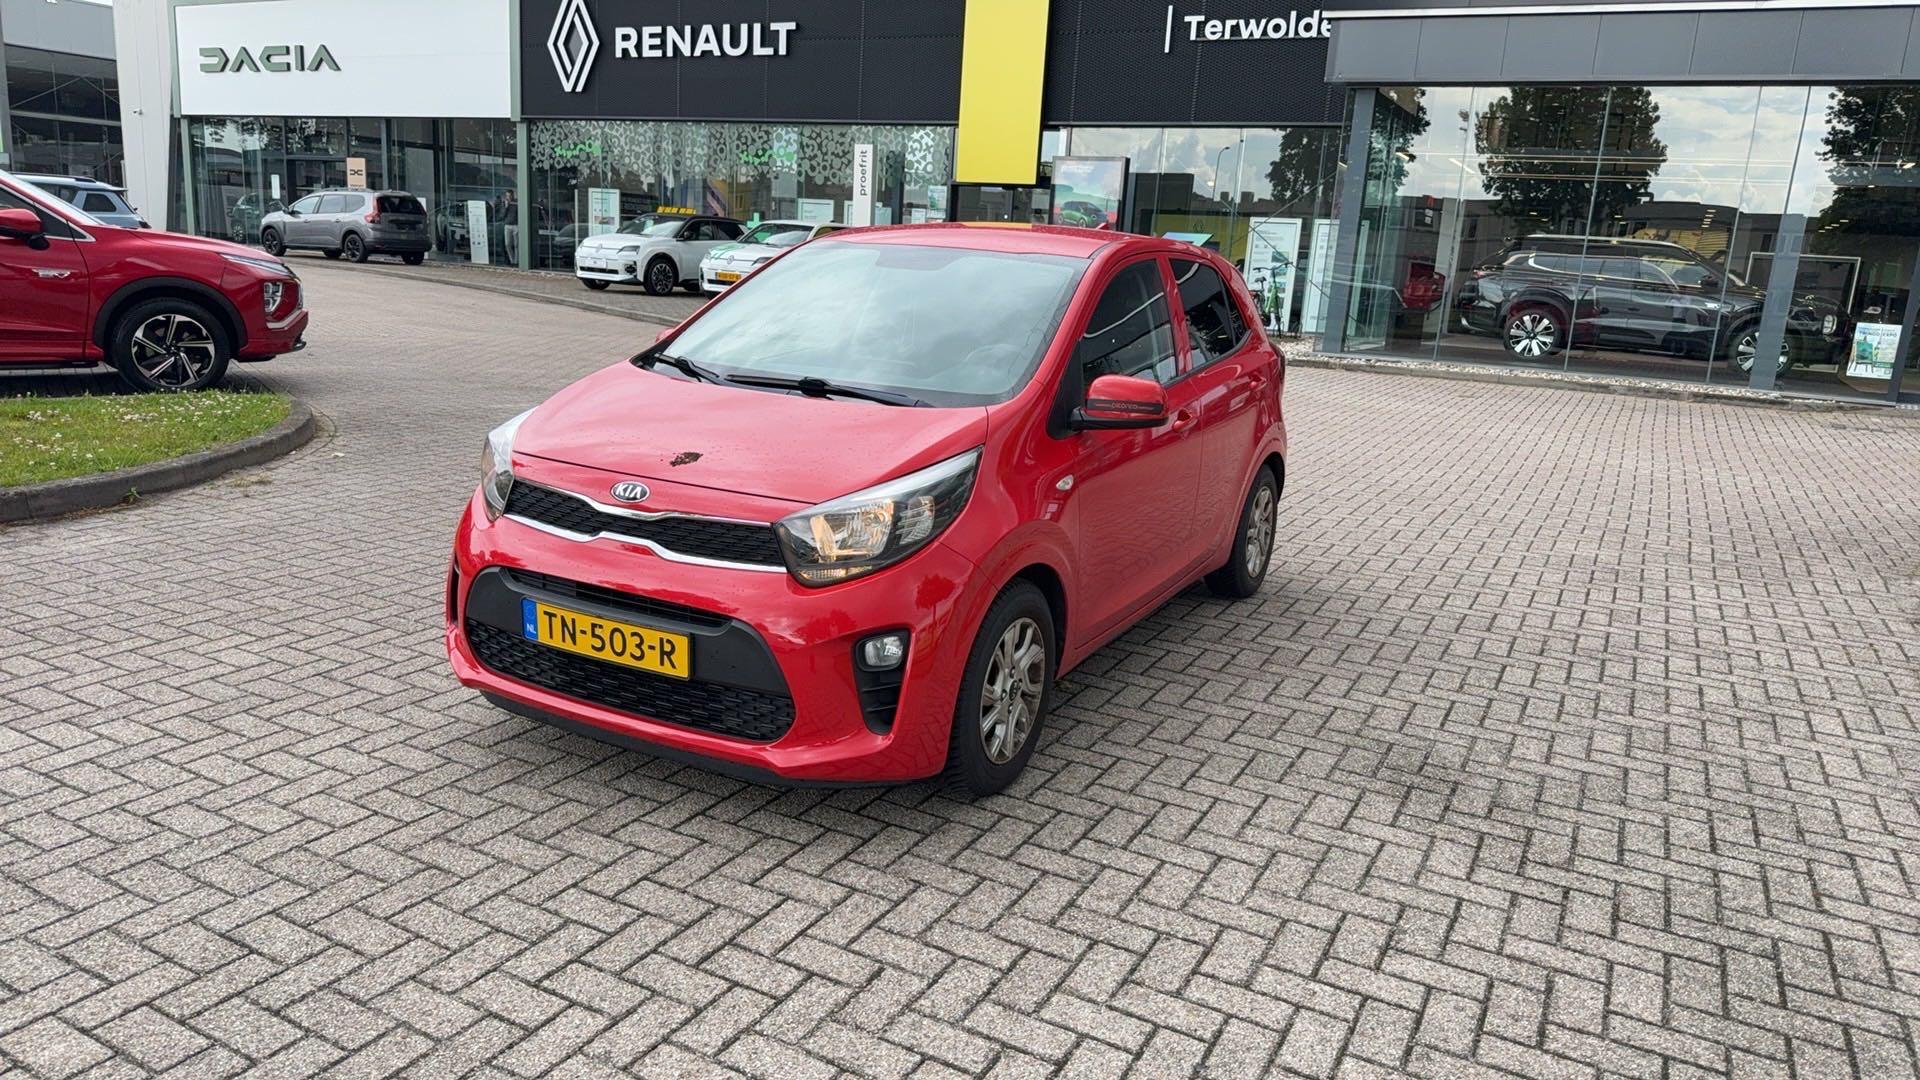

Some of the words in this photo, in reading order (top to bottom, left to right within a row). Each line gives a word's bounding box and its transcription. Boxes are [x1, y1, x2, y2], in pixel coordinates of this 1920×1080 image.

[615, 22, 796, 58] RENAULT
[199, 44, 341, 73] DACIA
[859, 149, 868, 196] proefrit
[615, 483, 642, 499] KIA
[526, 623, 537, 634] NL
[543, 610, 677, 669] TN-503-R
